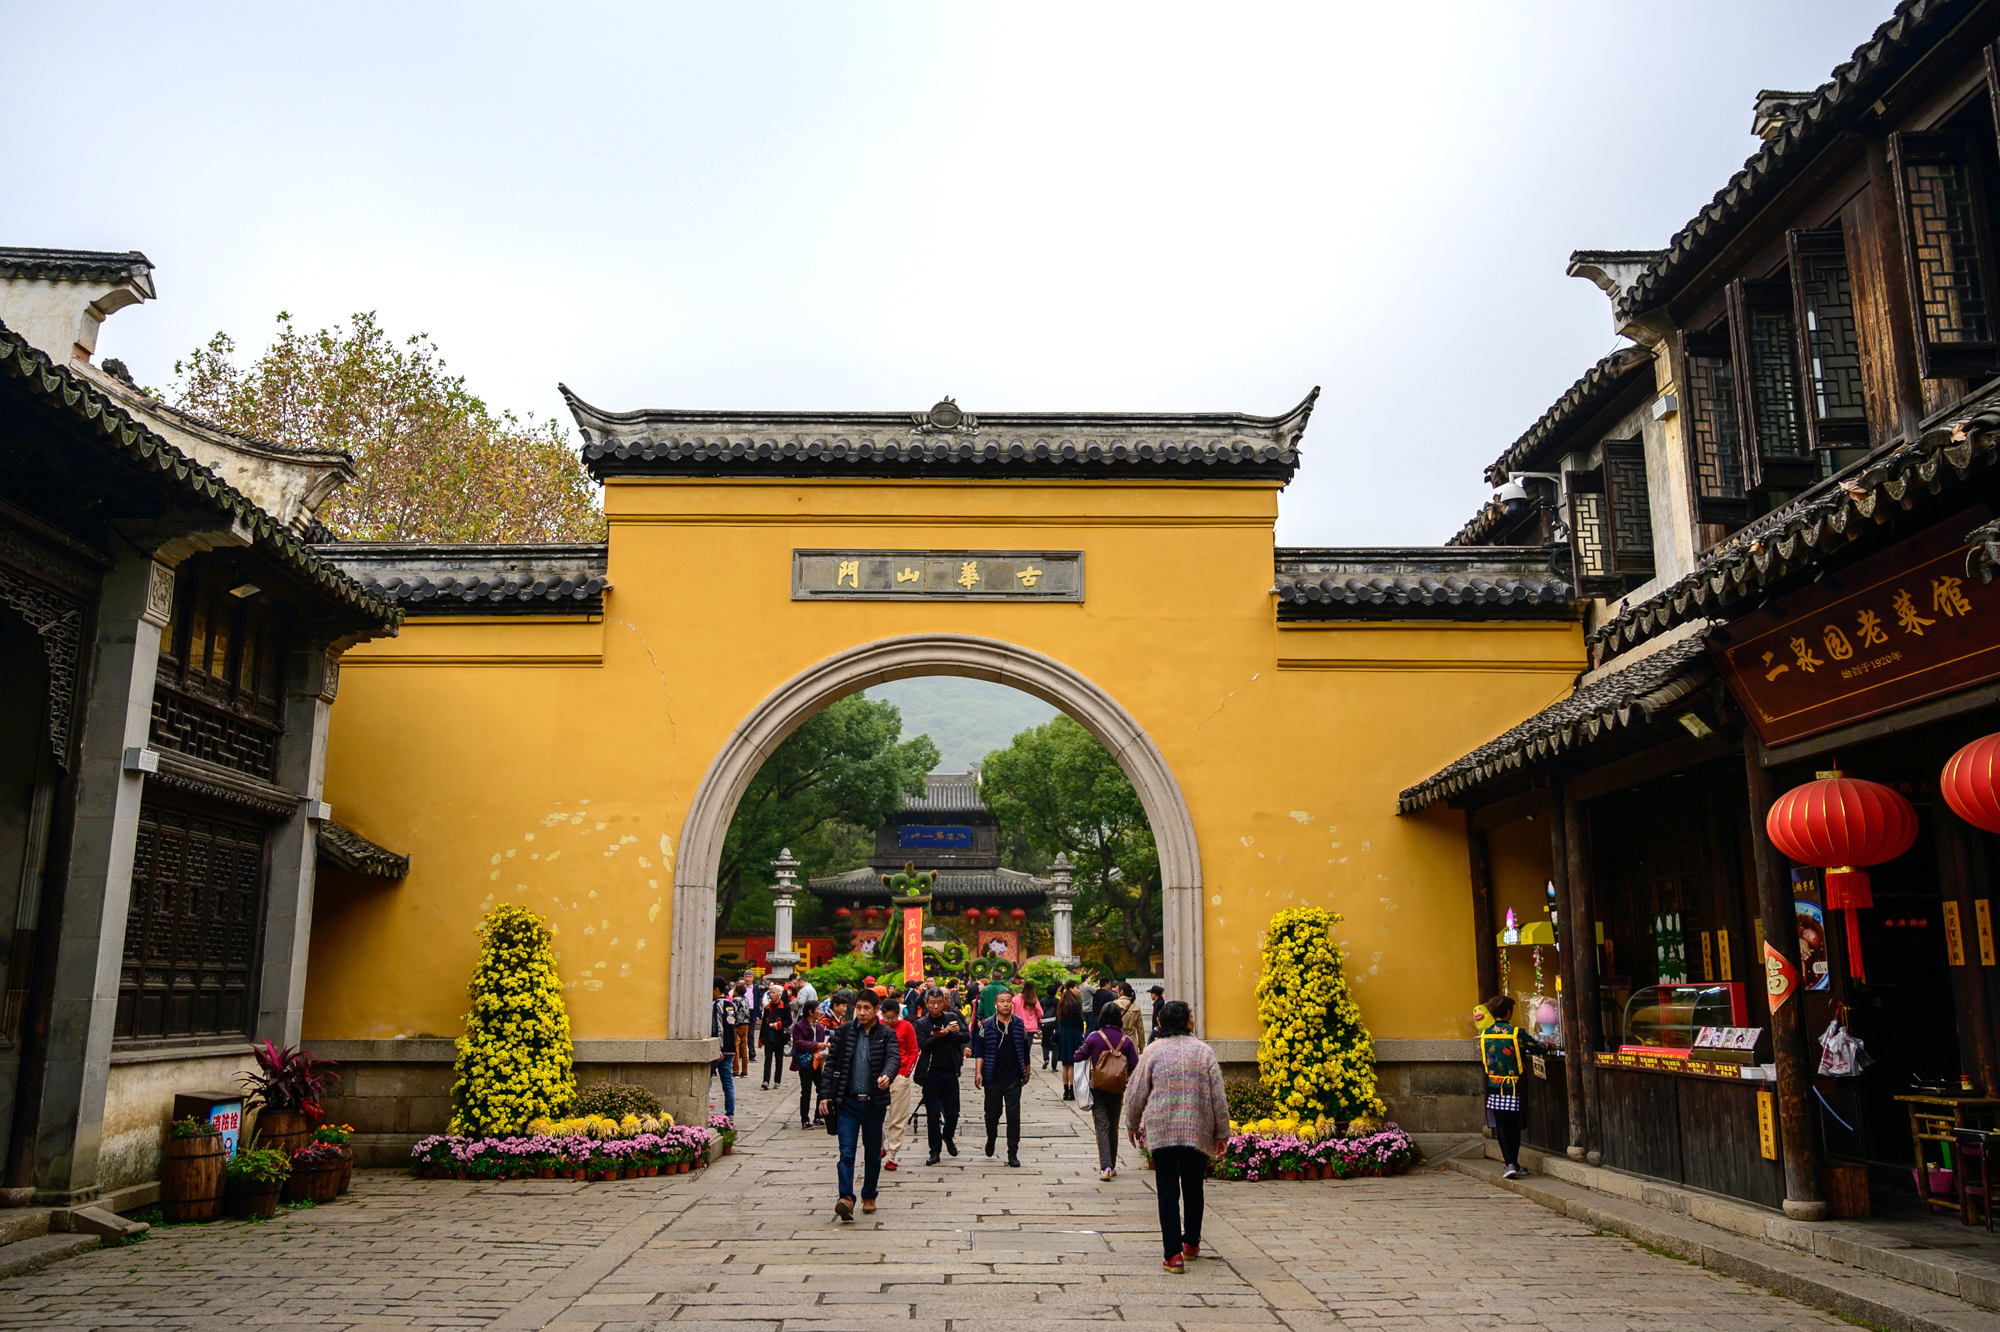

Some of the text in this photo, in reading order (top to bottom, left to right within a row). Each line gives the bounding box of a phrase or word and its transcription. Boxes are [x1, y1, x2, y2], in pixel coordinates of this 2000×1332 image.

[1841, 651, 1902, 680] 始创于1920年
[212, 1111, 239, 1132] 消防栓
